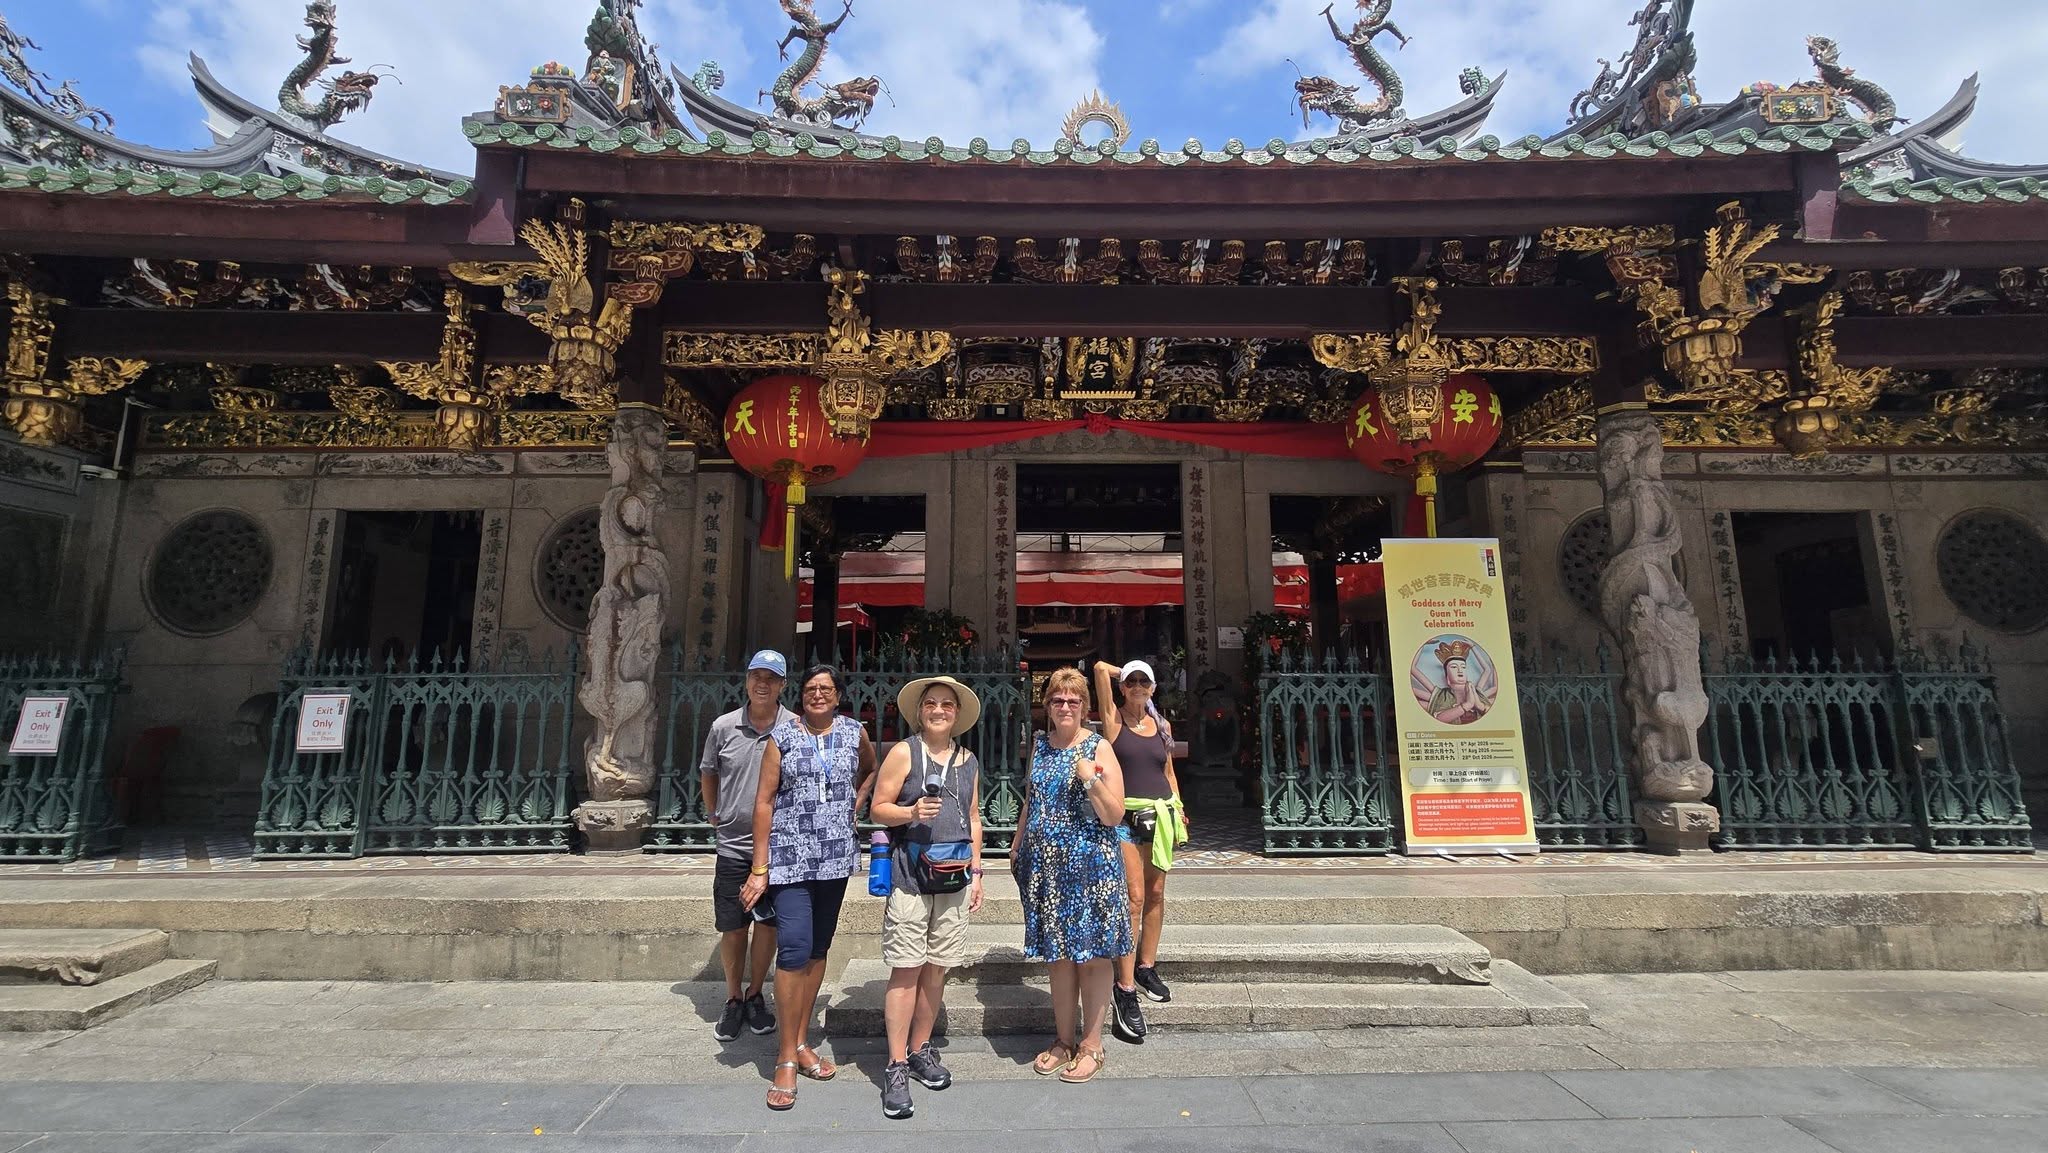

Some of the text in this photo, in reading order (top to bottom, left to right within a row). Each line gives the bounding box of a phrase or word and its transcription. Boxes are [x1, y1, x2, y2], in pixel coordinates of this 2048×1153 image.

[1088, 337, 1110, 379] 福宮
[733, 399, 757, 436] 天
[787, 385, 802, 448] 丙午年吉日
[1355, 402, 1379, 439] 天
[1398, 573, 1494, 599] 观世音菩萨庆典
[1411, 599, 1482, 608] Goddess of Mercy
[1454, 609, 1467, 617] Yin
[1424, 620, 1474, 628] Celebrations
[35, 710, 52, 718] Exit
[316, 707, 334, 715] Exit
[31, 722, 51, 732] Only
[312, 719, 334, 729] Only
